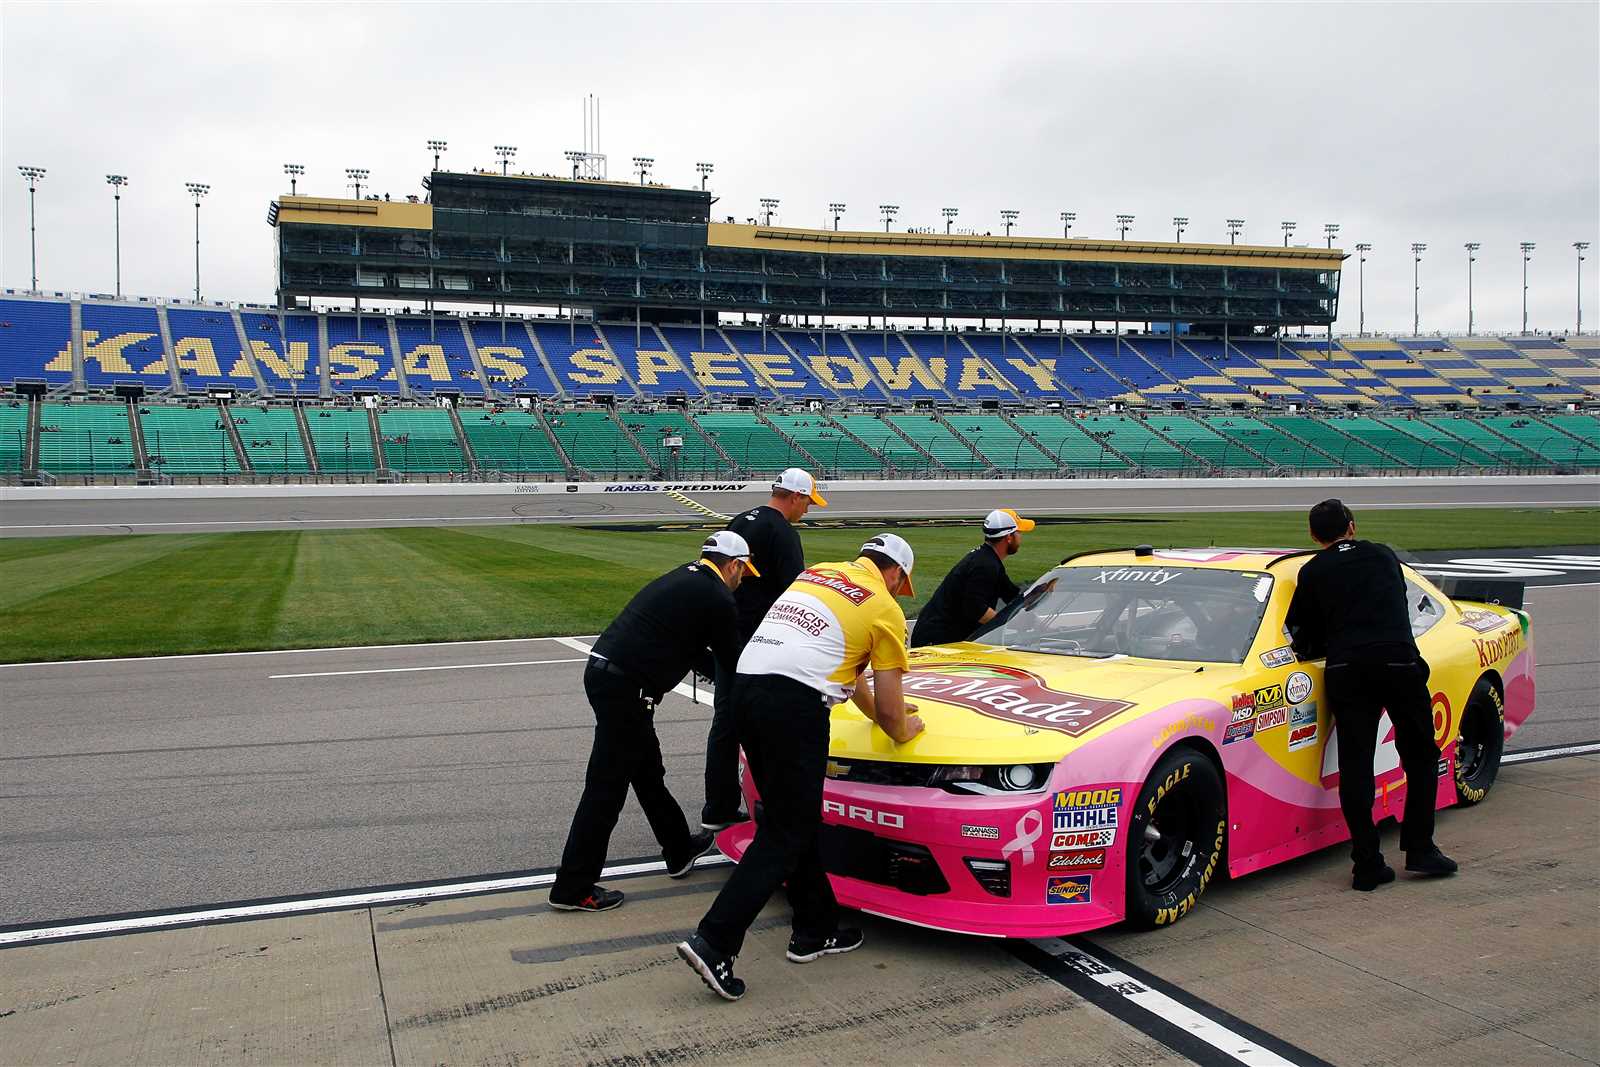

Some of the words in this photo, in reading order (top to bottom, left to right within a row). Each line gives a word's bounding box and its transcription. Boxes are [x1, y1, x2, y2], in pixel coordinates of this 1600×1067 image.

[44, 330, 528, 382] KANSAS
[568, 348, 1058, 391] SPEEDWAY
[662, 484, 747, 492] SPEEDWAY
[1092, 568, 1182, 586] xfinity
[1231, 707, 1253, 722] MSD
[1257, 707, 1287, 730] SIMPSON
[1055, 788, 1121, 808] MOOG
[1147, 763, 1192, 815] EAGLE
[823, 800, 904, 829] ARO
[1054, 807, 1117, 829] MAHLE
[1053, 832, 1100, 848] COMP
[1049, 853, 1103, 867] Edelbrock
[1048, 884, 1089, 894] SUNOCO
